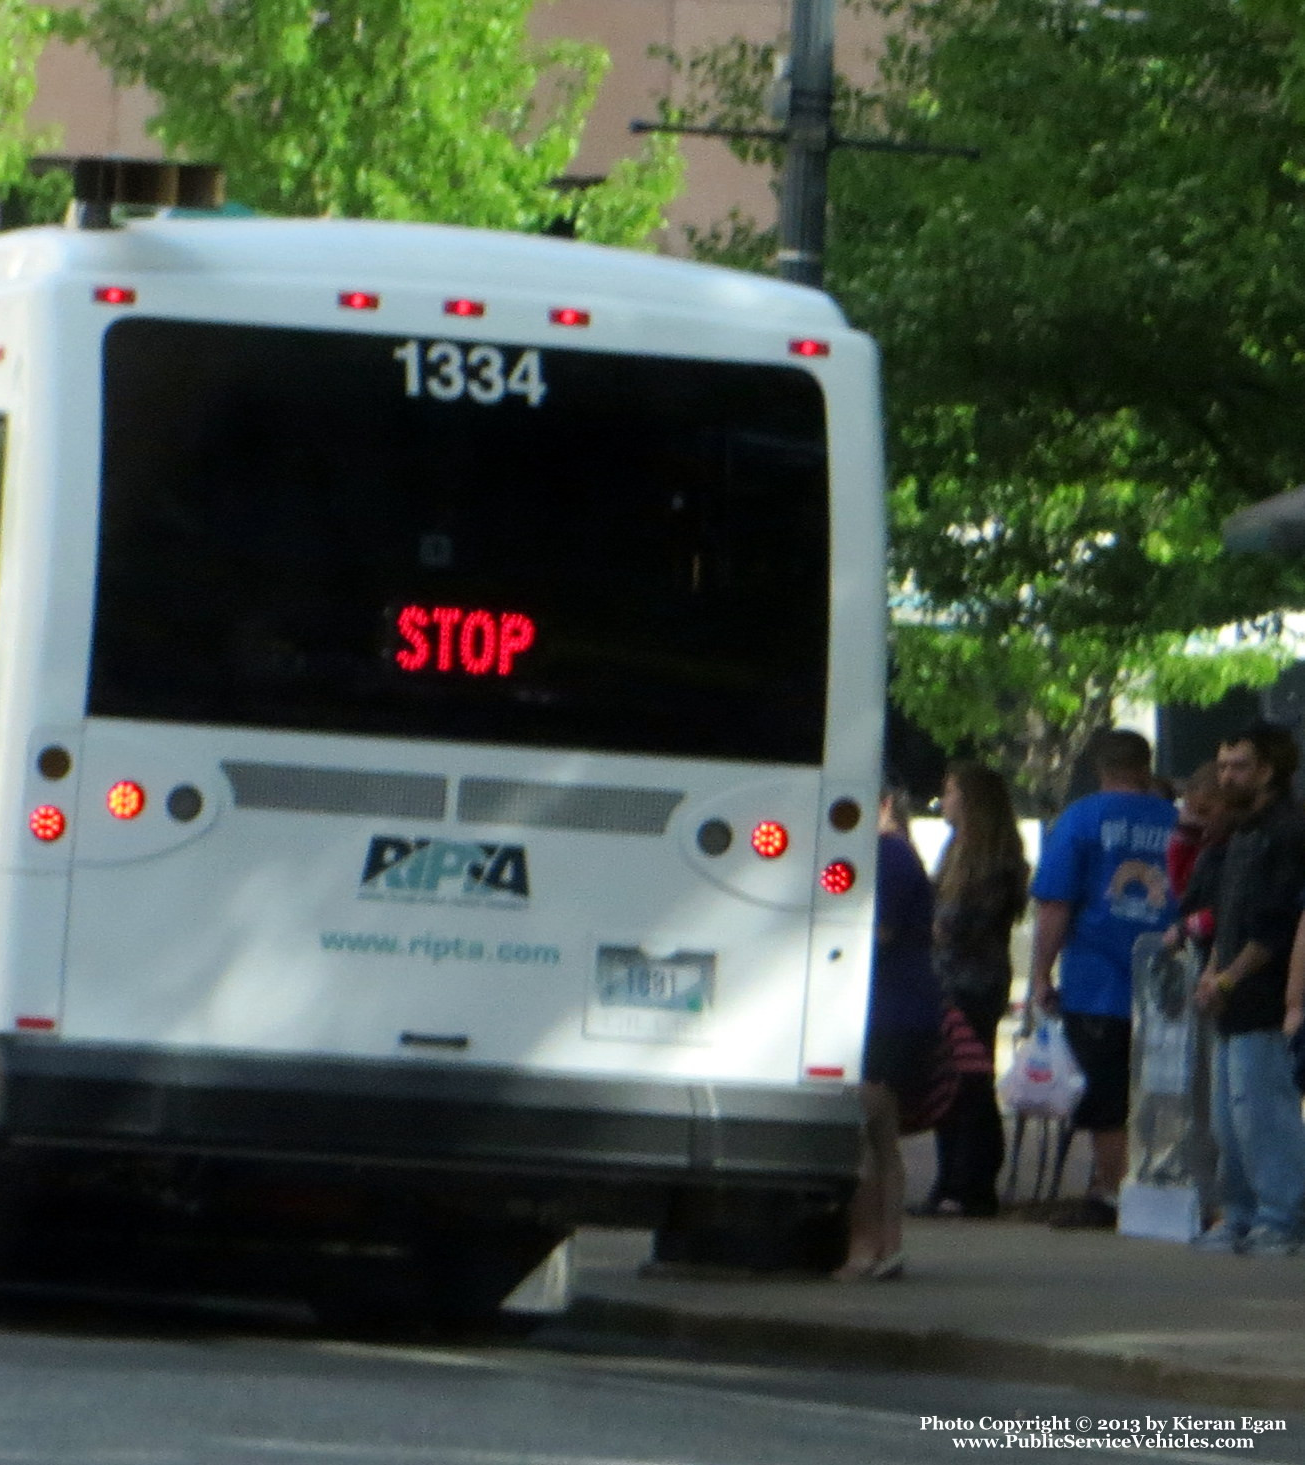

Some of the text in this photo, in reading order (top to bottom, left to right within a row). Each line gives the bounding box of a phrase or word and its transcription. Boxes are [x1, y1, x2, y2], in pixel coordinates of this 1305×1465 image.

[394, 340, 547, 407] 1334
[396, 605, 536, 676] STOP
[320, 930, 561, 966] www.ripta.com
